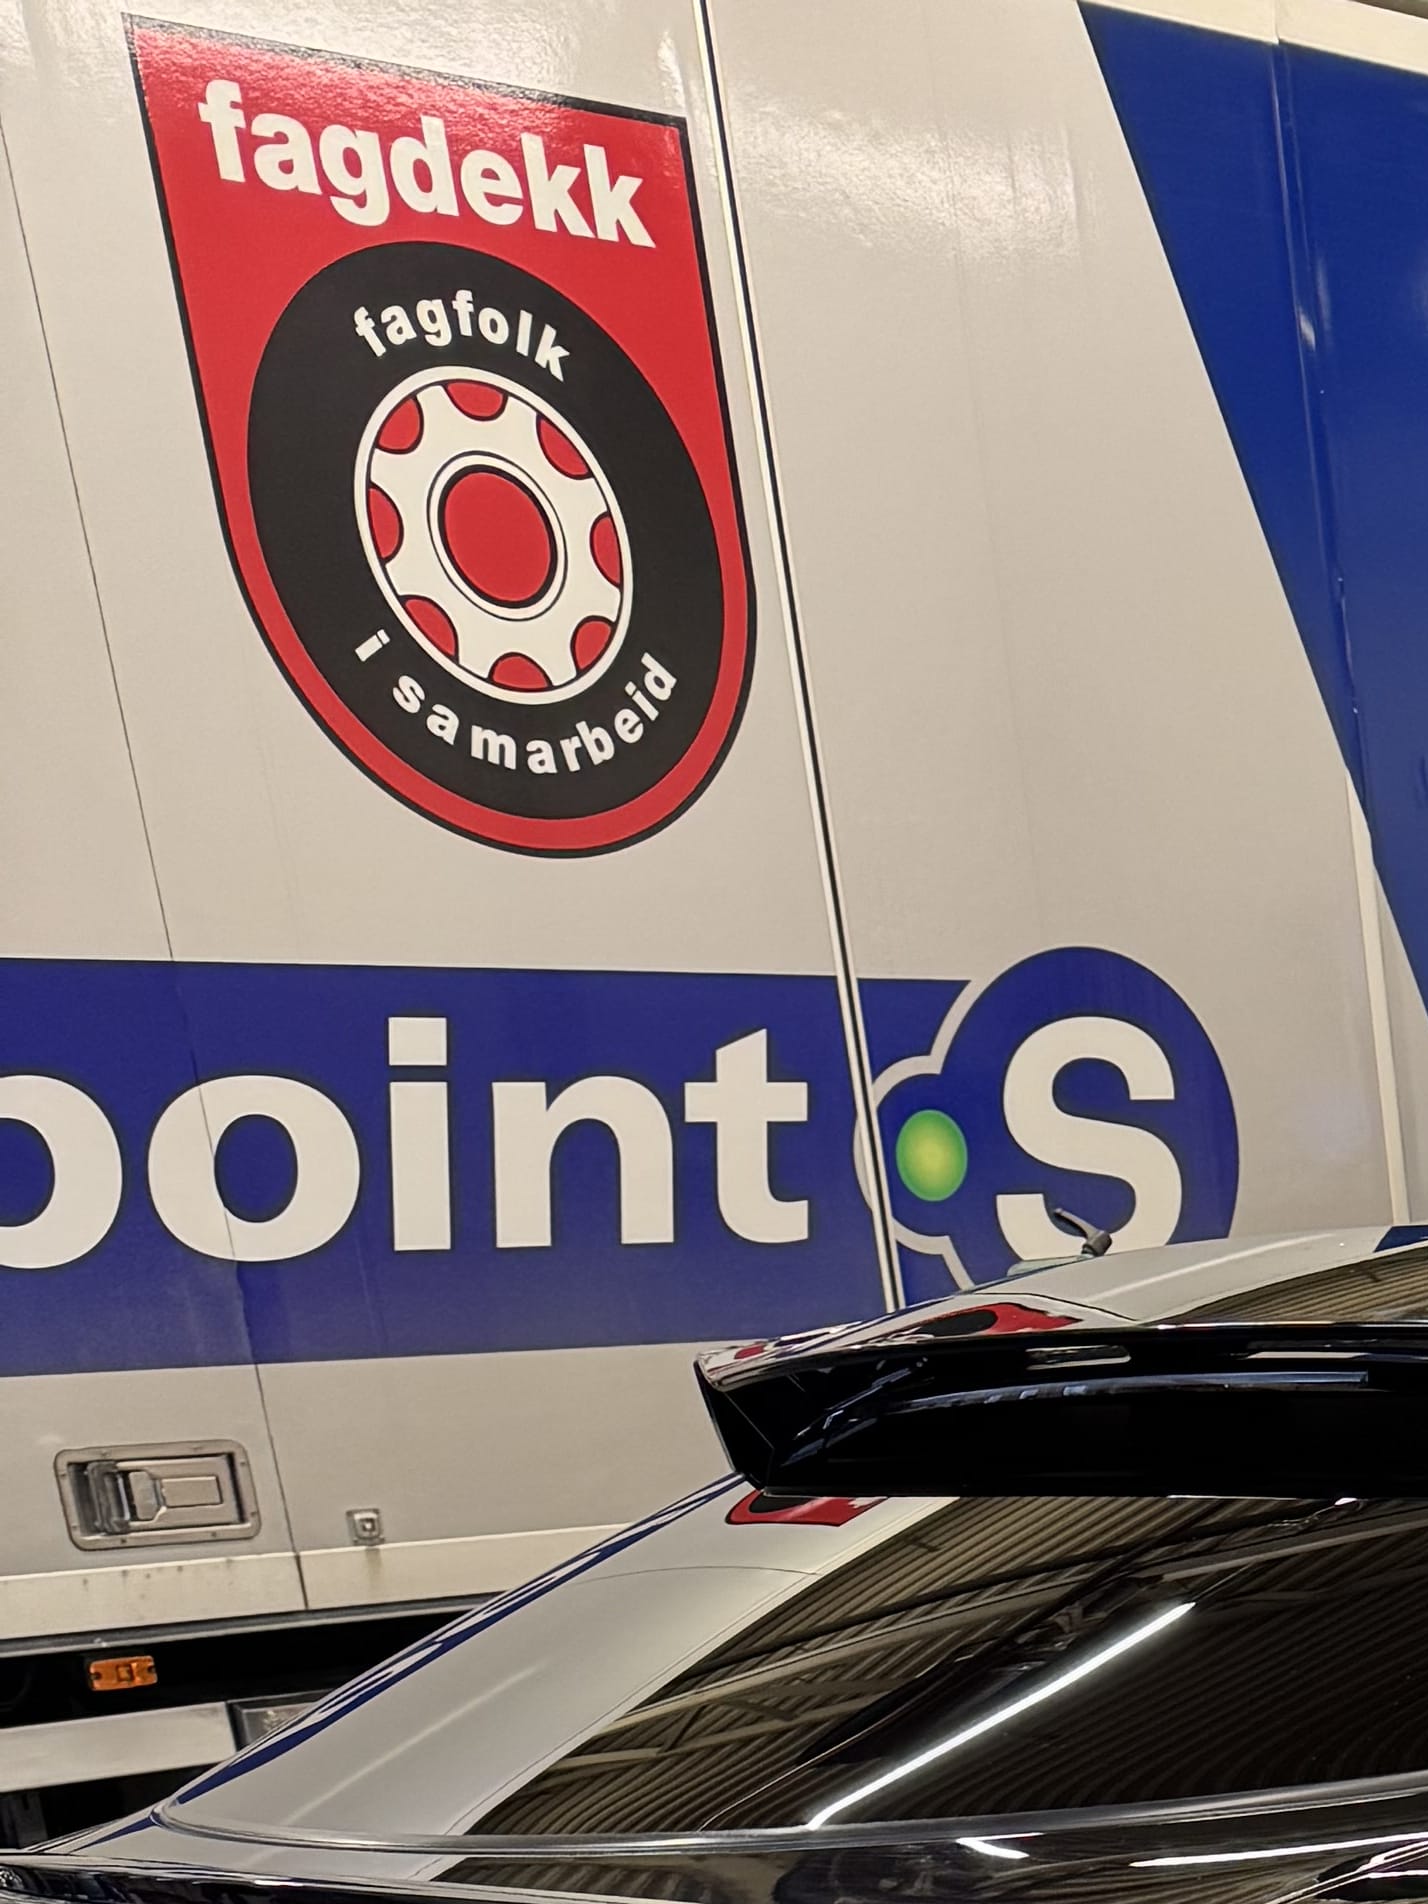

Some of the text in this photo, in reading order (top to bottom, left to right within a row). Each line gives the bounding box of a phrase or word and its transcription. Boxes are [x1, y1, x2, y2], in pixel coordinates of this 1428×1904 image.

[198, 79, 656, 249] fagdekk
[354, 289, 570, 381] fagfolk
[355, 629, 677, 775] i samarbeid
[996, 1015, 1184, 1262] S
